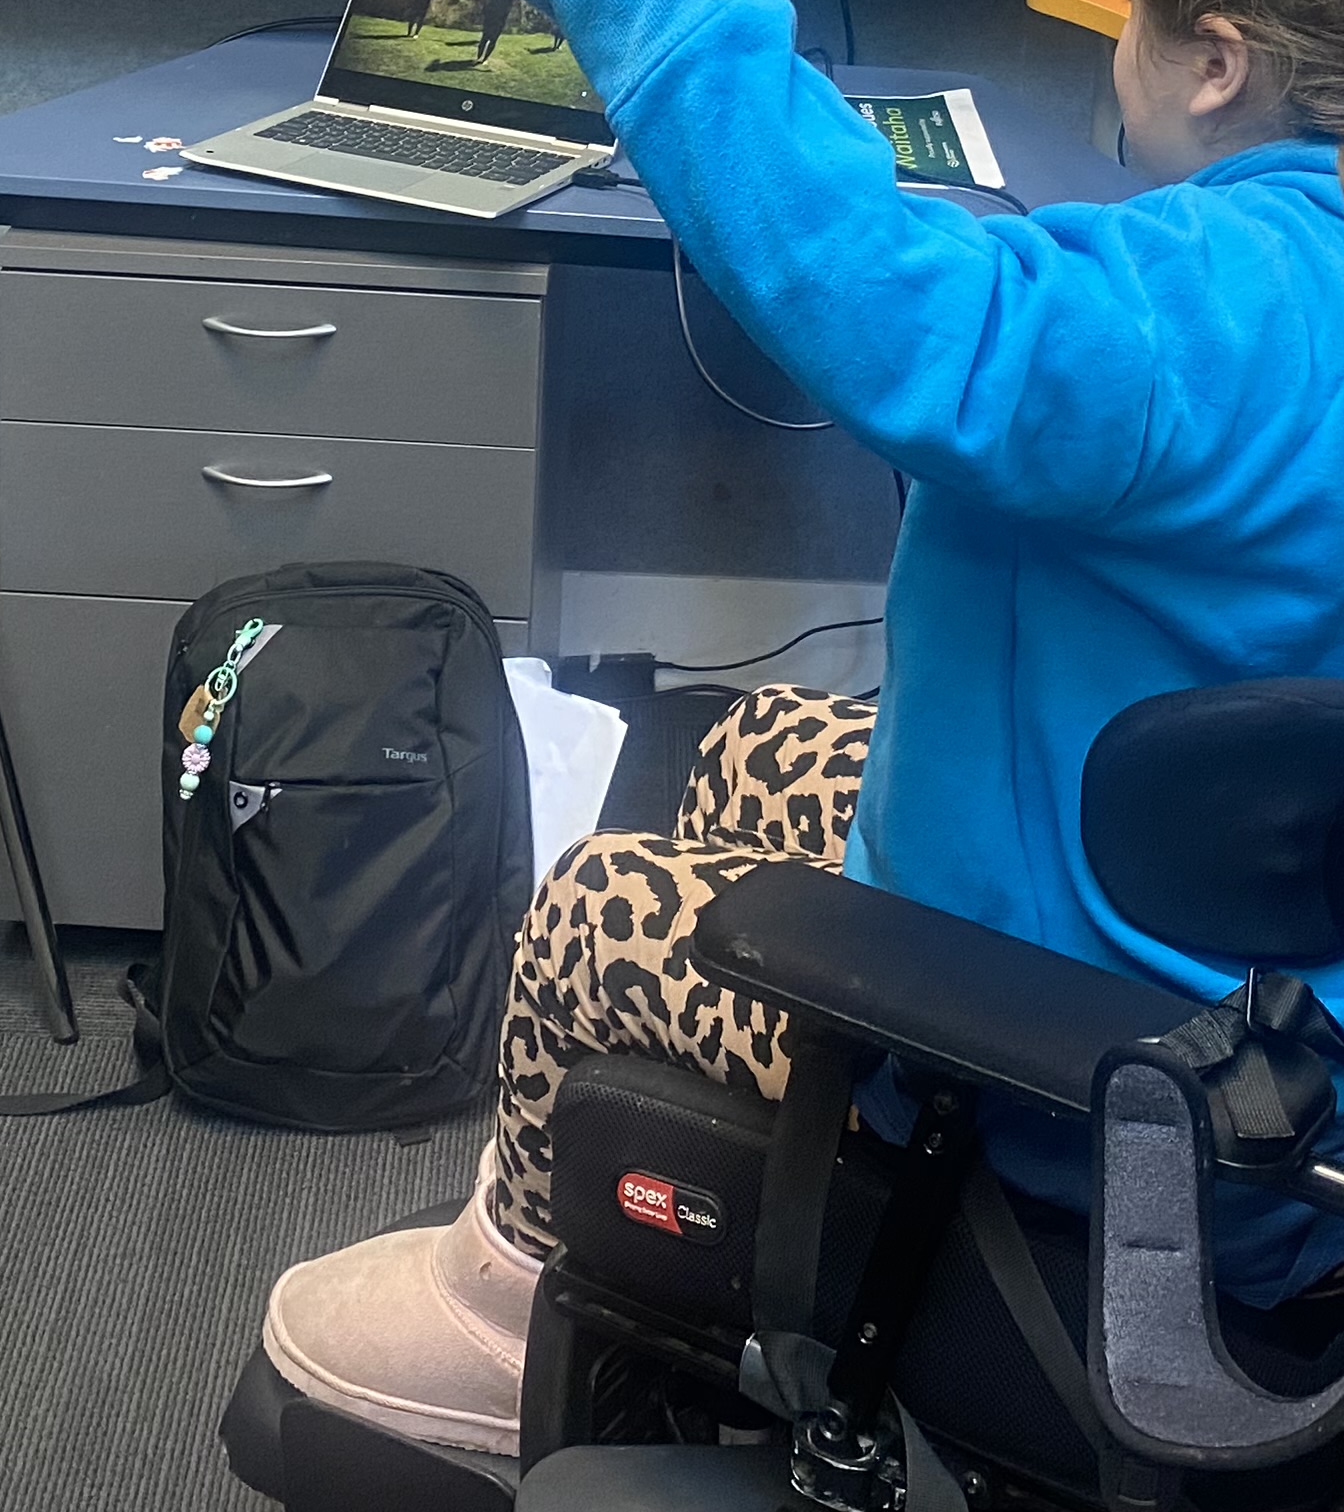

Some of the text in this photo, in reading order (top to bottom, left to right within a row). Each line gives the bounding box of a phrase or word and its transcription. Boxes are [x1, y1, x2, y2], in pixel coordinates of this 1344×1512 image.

[882, 107, 918, 170] Waitaha
[382, 747, 427, 763] Targus
[623, 1181, 667, 1209] spex
[677, 1204, 717, 1229] Classic
